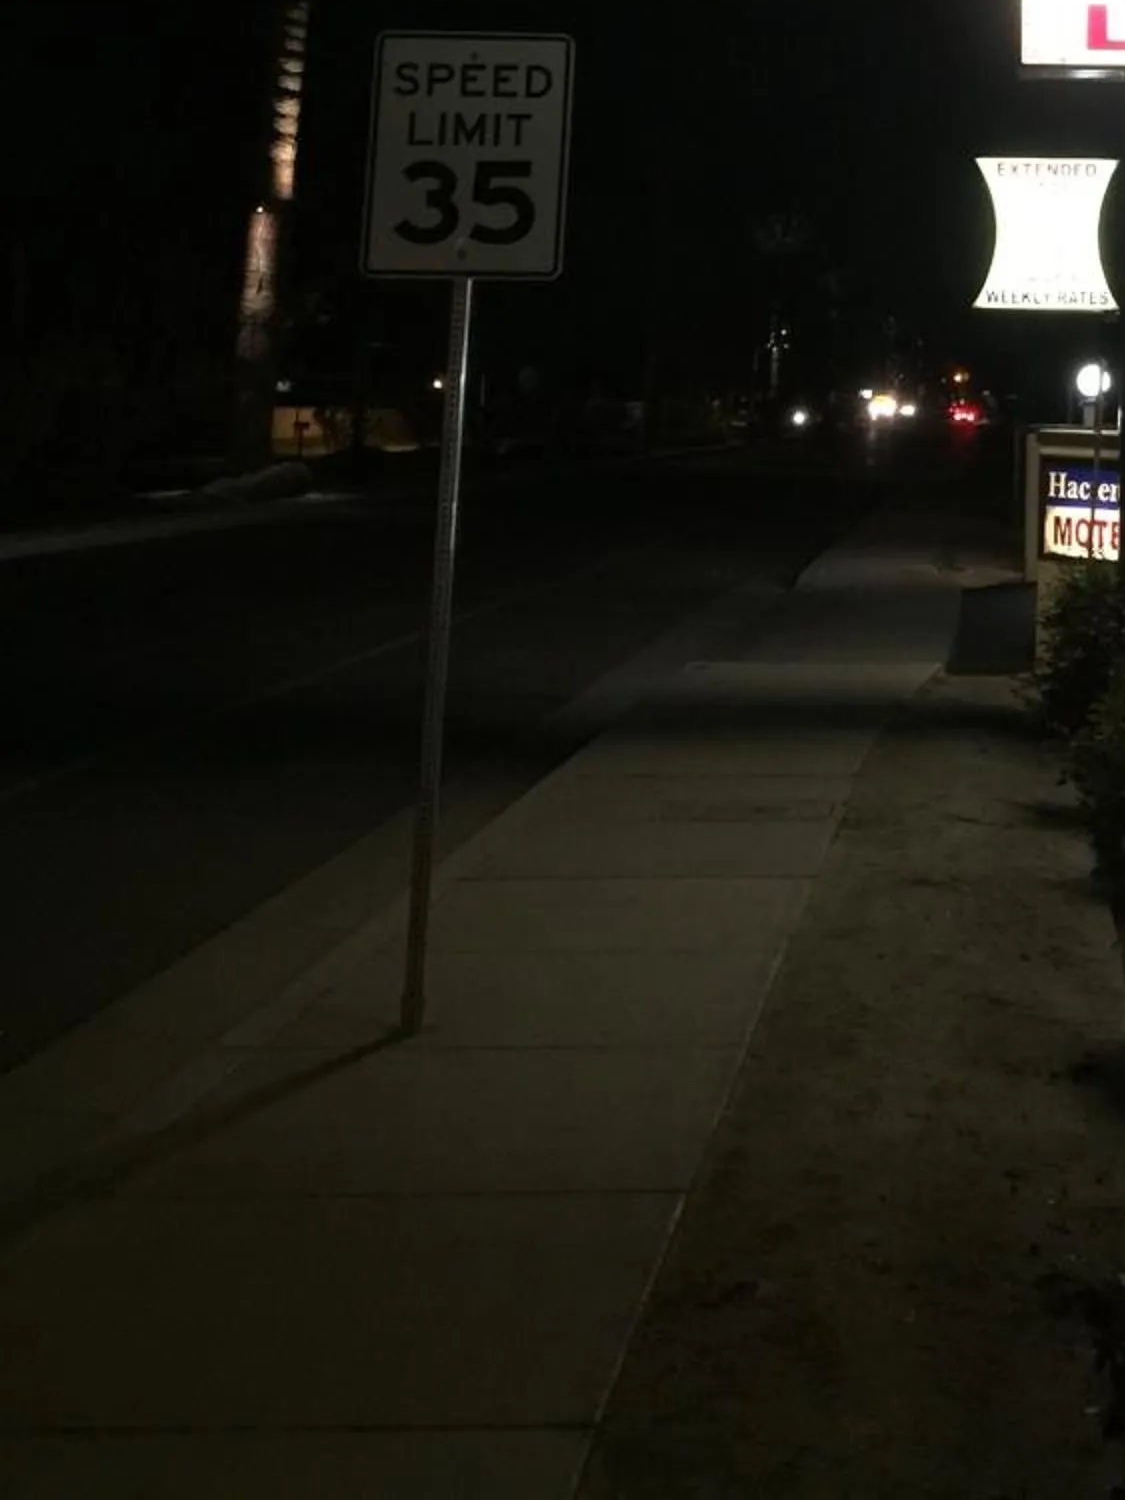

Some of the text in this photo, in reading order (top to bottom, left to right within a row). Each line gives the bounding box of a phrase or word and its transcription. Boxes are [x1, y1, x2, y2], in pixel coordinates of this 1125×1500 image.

[393, 62, 553, 98] SPEED
[407, 111, 534, 147] LIMIT
[996, 162, 1098, 178] EXTENDED
[393, 160, 536, 245] 35
[985, 289, 1109, 305] WEEKLY RATES
[1048, 471, 1120, 502] Hacen
